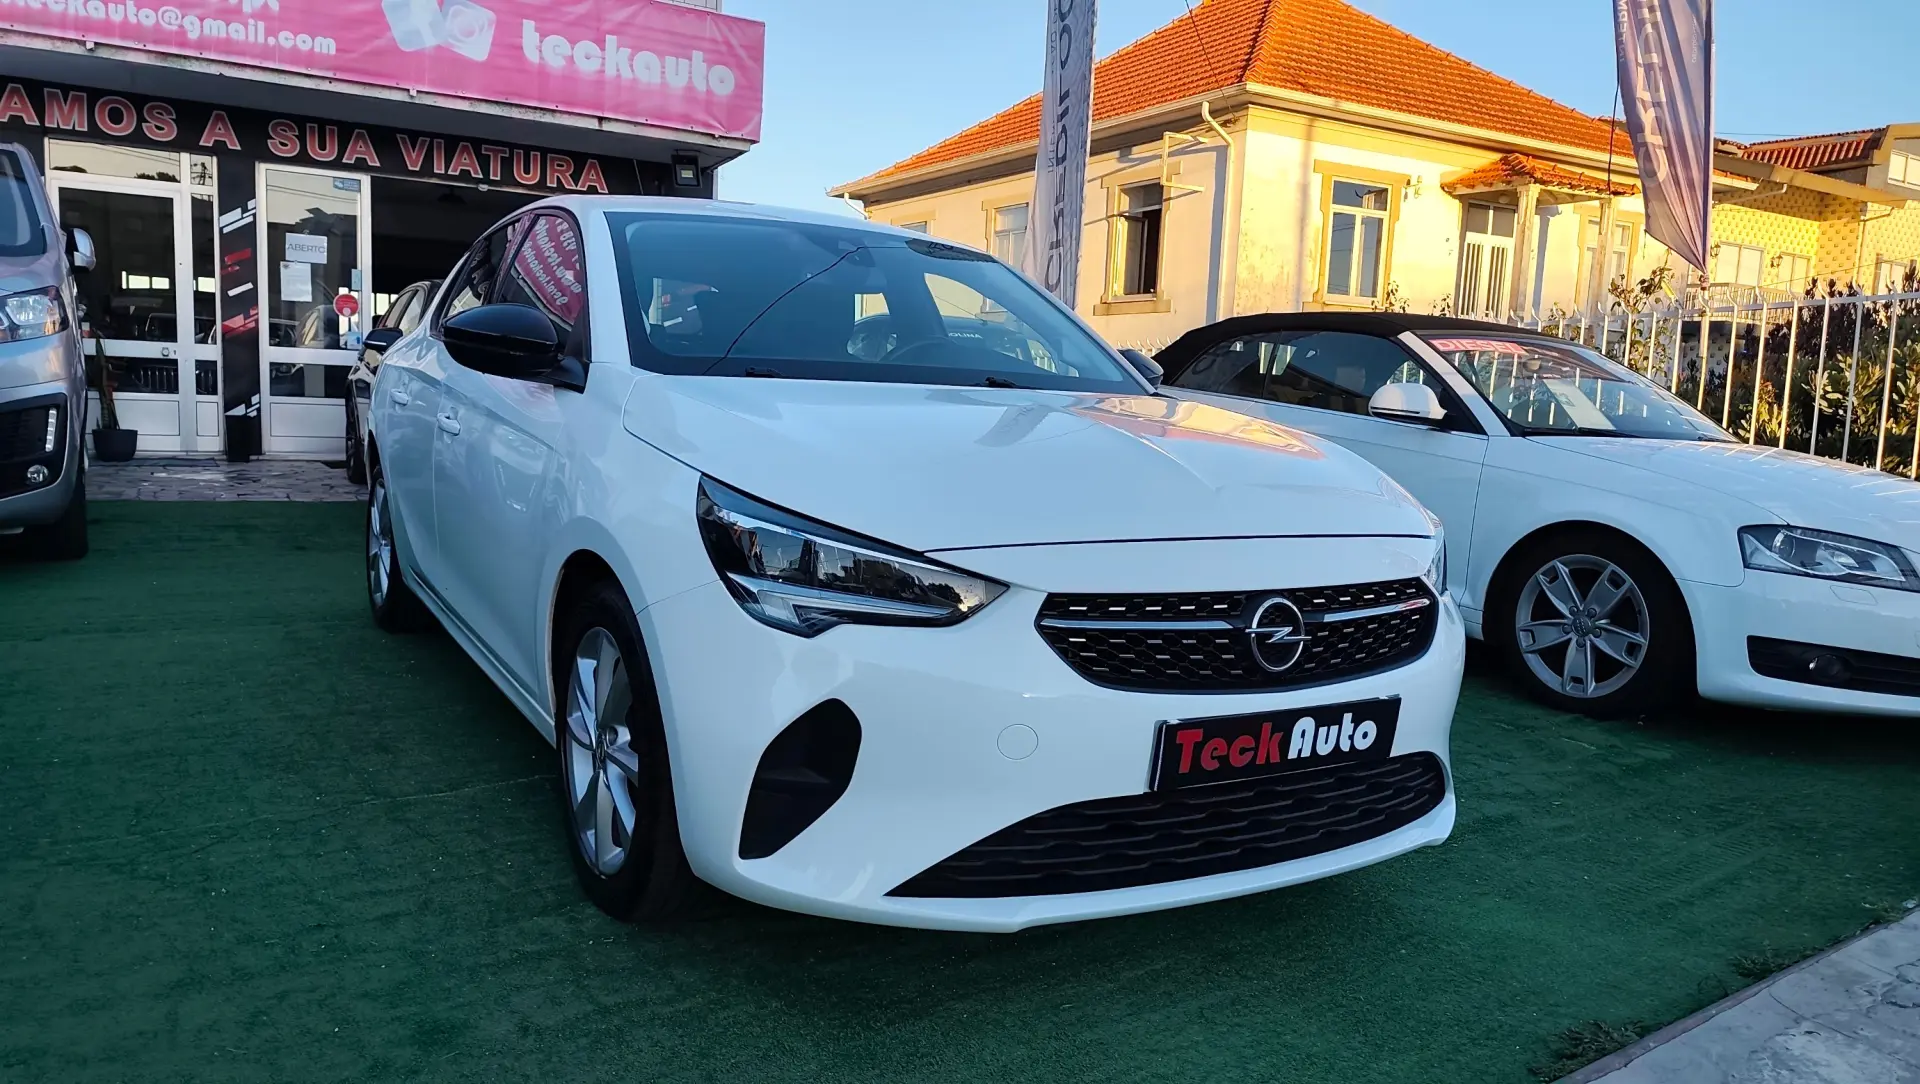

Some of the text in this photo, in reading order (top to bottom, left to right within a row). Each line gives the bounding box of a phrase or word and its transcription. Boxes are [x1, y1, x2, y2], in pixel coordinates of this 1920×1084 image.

[522, 19, 735, 96] teckauto
[0, 83, 609, 194] AMOS A SUA VIATURA
[1437, 339, 1521, 354] DIESEL
